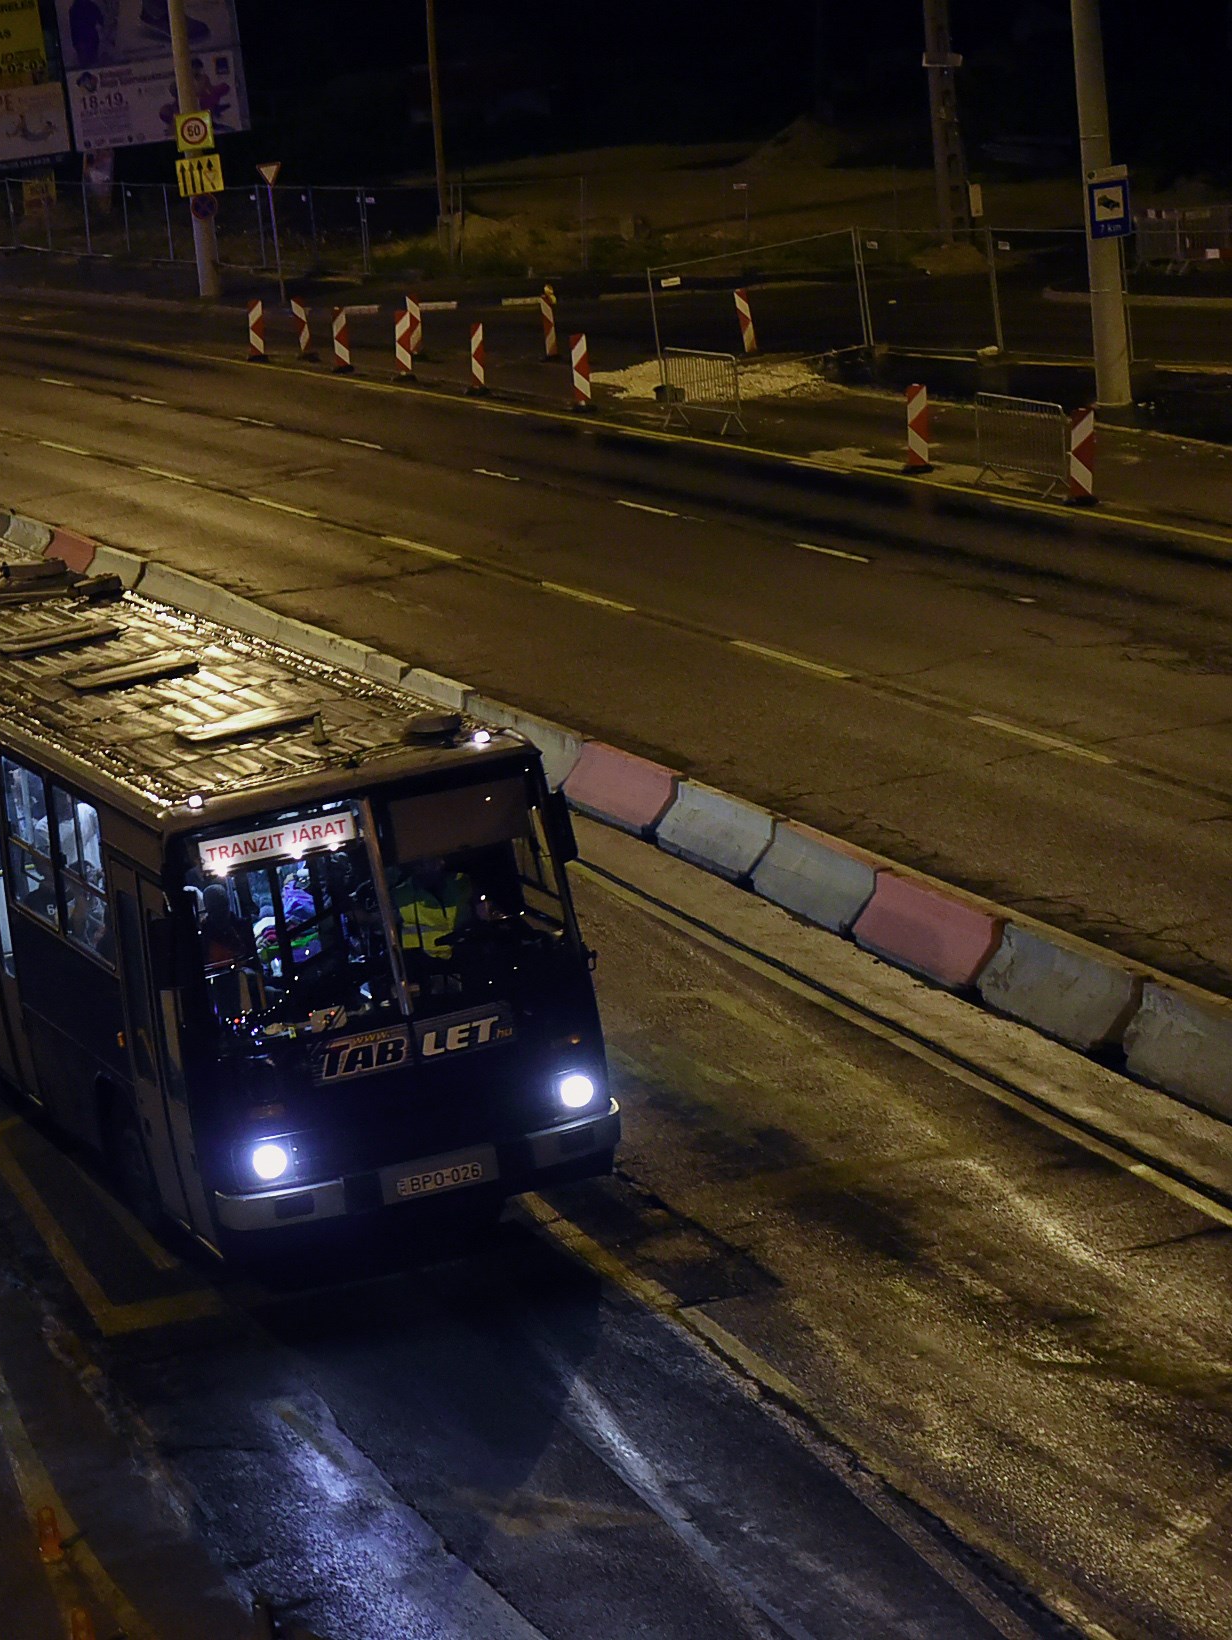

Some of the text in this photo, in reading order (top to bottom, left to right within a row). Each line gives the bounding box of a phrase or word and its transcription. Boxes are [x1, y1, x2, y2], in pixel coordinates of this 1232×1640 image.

[206, 819, 346, 862] TRANZIT JÁRAT
[409, 1163, 481, 1192] BPO-026
